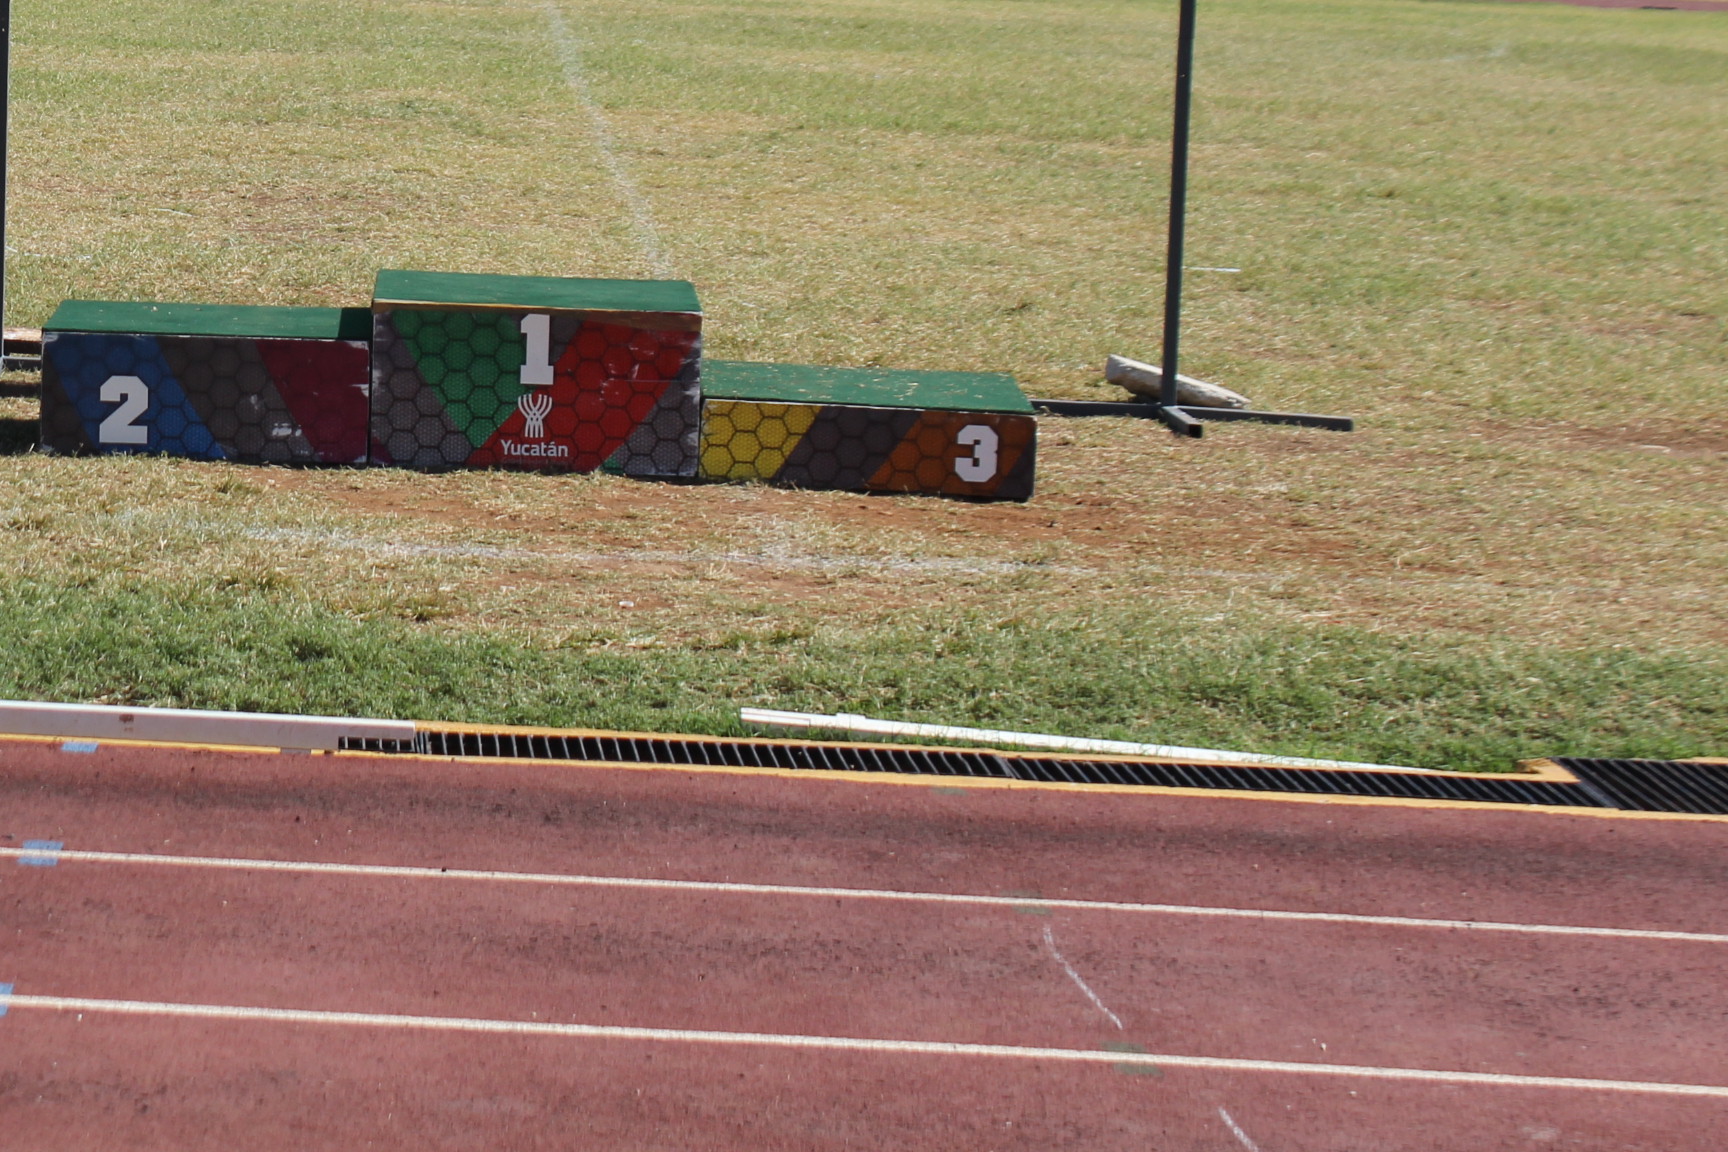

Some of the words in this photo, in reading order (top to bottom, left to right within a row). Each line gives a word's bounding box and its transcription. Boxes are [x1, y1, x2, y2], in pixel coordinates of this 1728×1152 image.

[519, 314, 554, 385] 1
[99, 375, 149, 444] 2
[500, 439, 569, 457] Yucatán
[954, 424, 998, 483] 3
